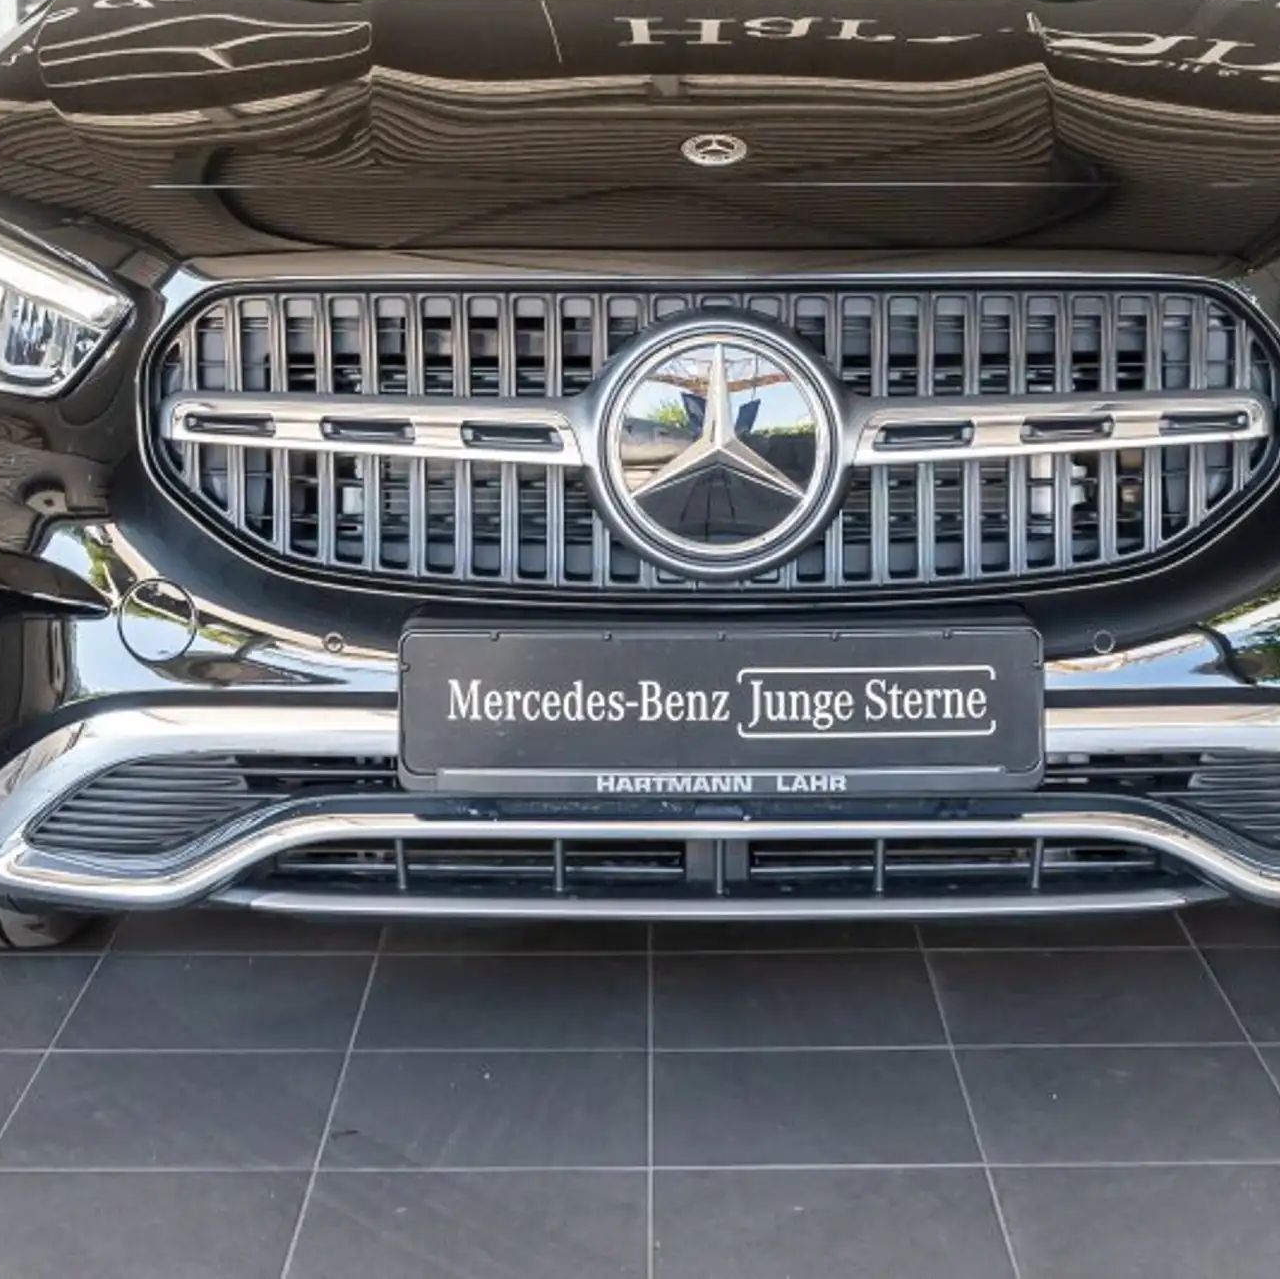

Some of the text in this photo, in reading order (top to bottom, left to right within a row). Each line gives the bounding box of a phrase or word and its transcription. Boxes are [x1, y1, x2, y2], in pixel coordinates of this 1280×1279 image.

[447, 678, 987, 730] Mercedes-Benz Junge Sterne
[596, 774, 847, 793] HARTMANN LAHR
